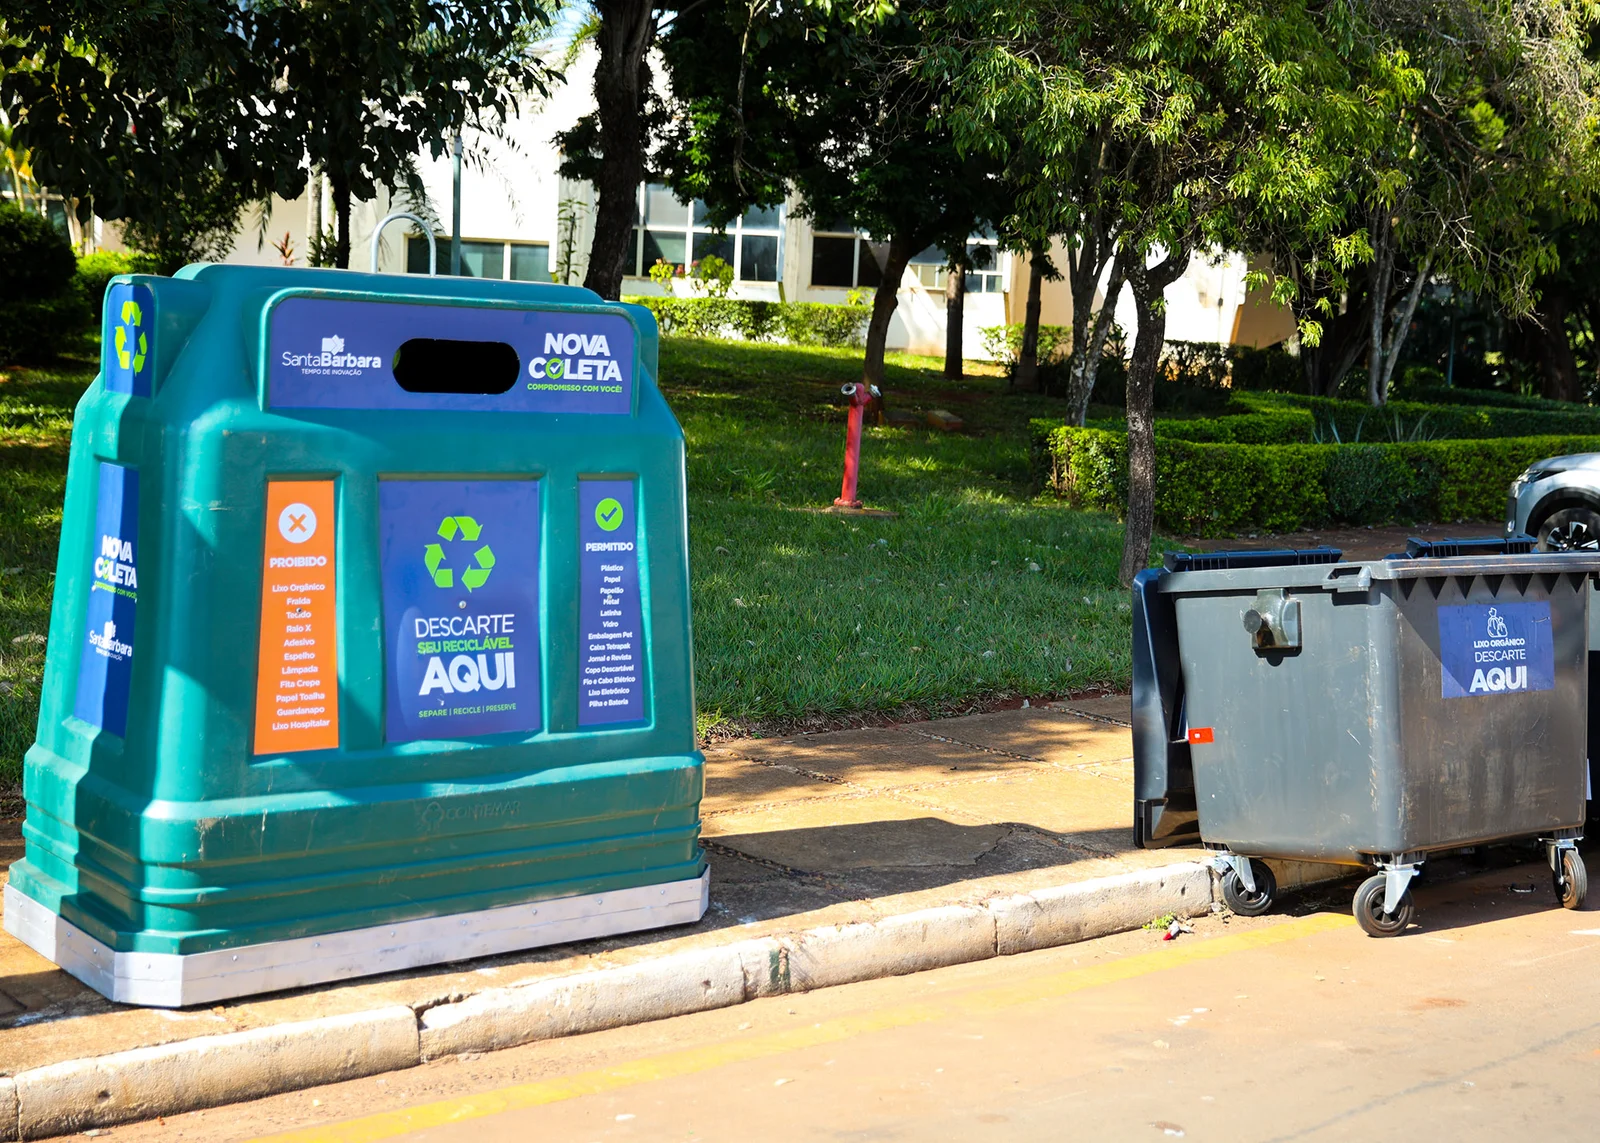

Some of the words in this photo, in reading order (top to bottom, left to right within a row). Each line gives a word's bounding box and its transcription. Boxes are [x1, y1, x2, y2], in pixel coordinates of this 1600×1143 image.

[544, 333, 611, 357] NOVA
[282, 351, 381, 370] SantaBarbara
[331, 368, 362, 376] INOVAÇÃO
[528, 357, 623, 382] COLETA
[527, 383, 581, 392] COMPROMISSO
[583, 384, 599, 392] COM
[600, 383, 623, 393] VOCÊ!
[102, 535, 132, 563] NOVA
[586, 542, 633, 552] PERMITIDO
[270, 556, 327, 568] PROIBIDO
[95, 557, 137, 588] COLETA
[290, 583, 325, 592] Orgânico
[600, 587, 623, 595] Papelão
[415, 614, 515, 638] DESCARTE
[588, 632, 622, 640] Embalagem
[284, 639, 315, 647] Adesivo
[417, 642, 441, 654] SEU
[443, 635, 513, 652] RECICLÁVEL
[606, 643, 630, 651] Tetrapak
[1490, 638, 1525, 647] ORGÂNICO
[284, 652, 315, 661] Espelho
[1475, 649, 1526, 662] DESCARTE
[282, 665, 318, 675] Lâmpada
[418, 652, 515, 696] AQUI
[585, 667, 601, 675] Copo
[602, 665, 634, 673] Descartável
[297, 679, 320, 688] Crepe
[1469, 665, 1527, 692] AQUI
[602, 687, 630, 695] Eletrônico
[276, 694, 298, 703] Papel
[300, 692, 325, 701] Toalha
[277, 707, 325, 716] Guardanapo
[419, 709, 447, 718] SEPARE
[453, 706, 481, 715] RECICLE
[486, 703, 516, 712] PRESERVE
[290, 720, 330, 730] Hospitalar
